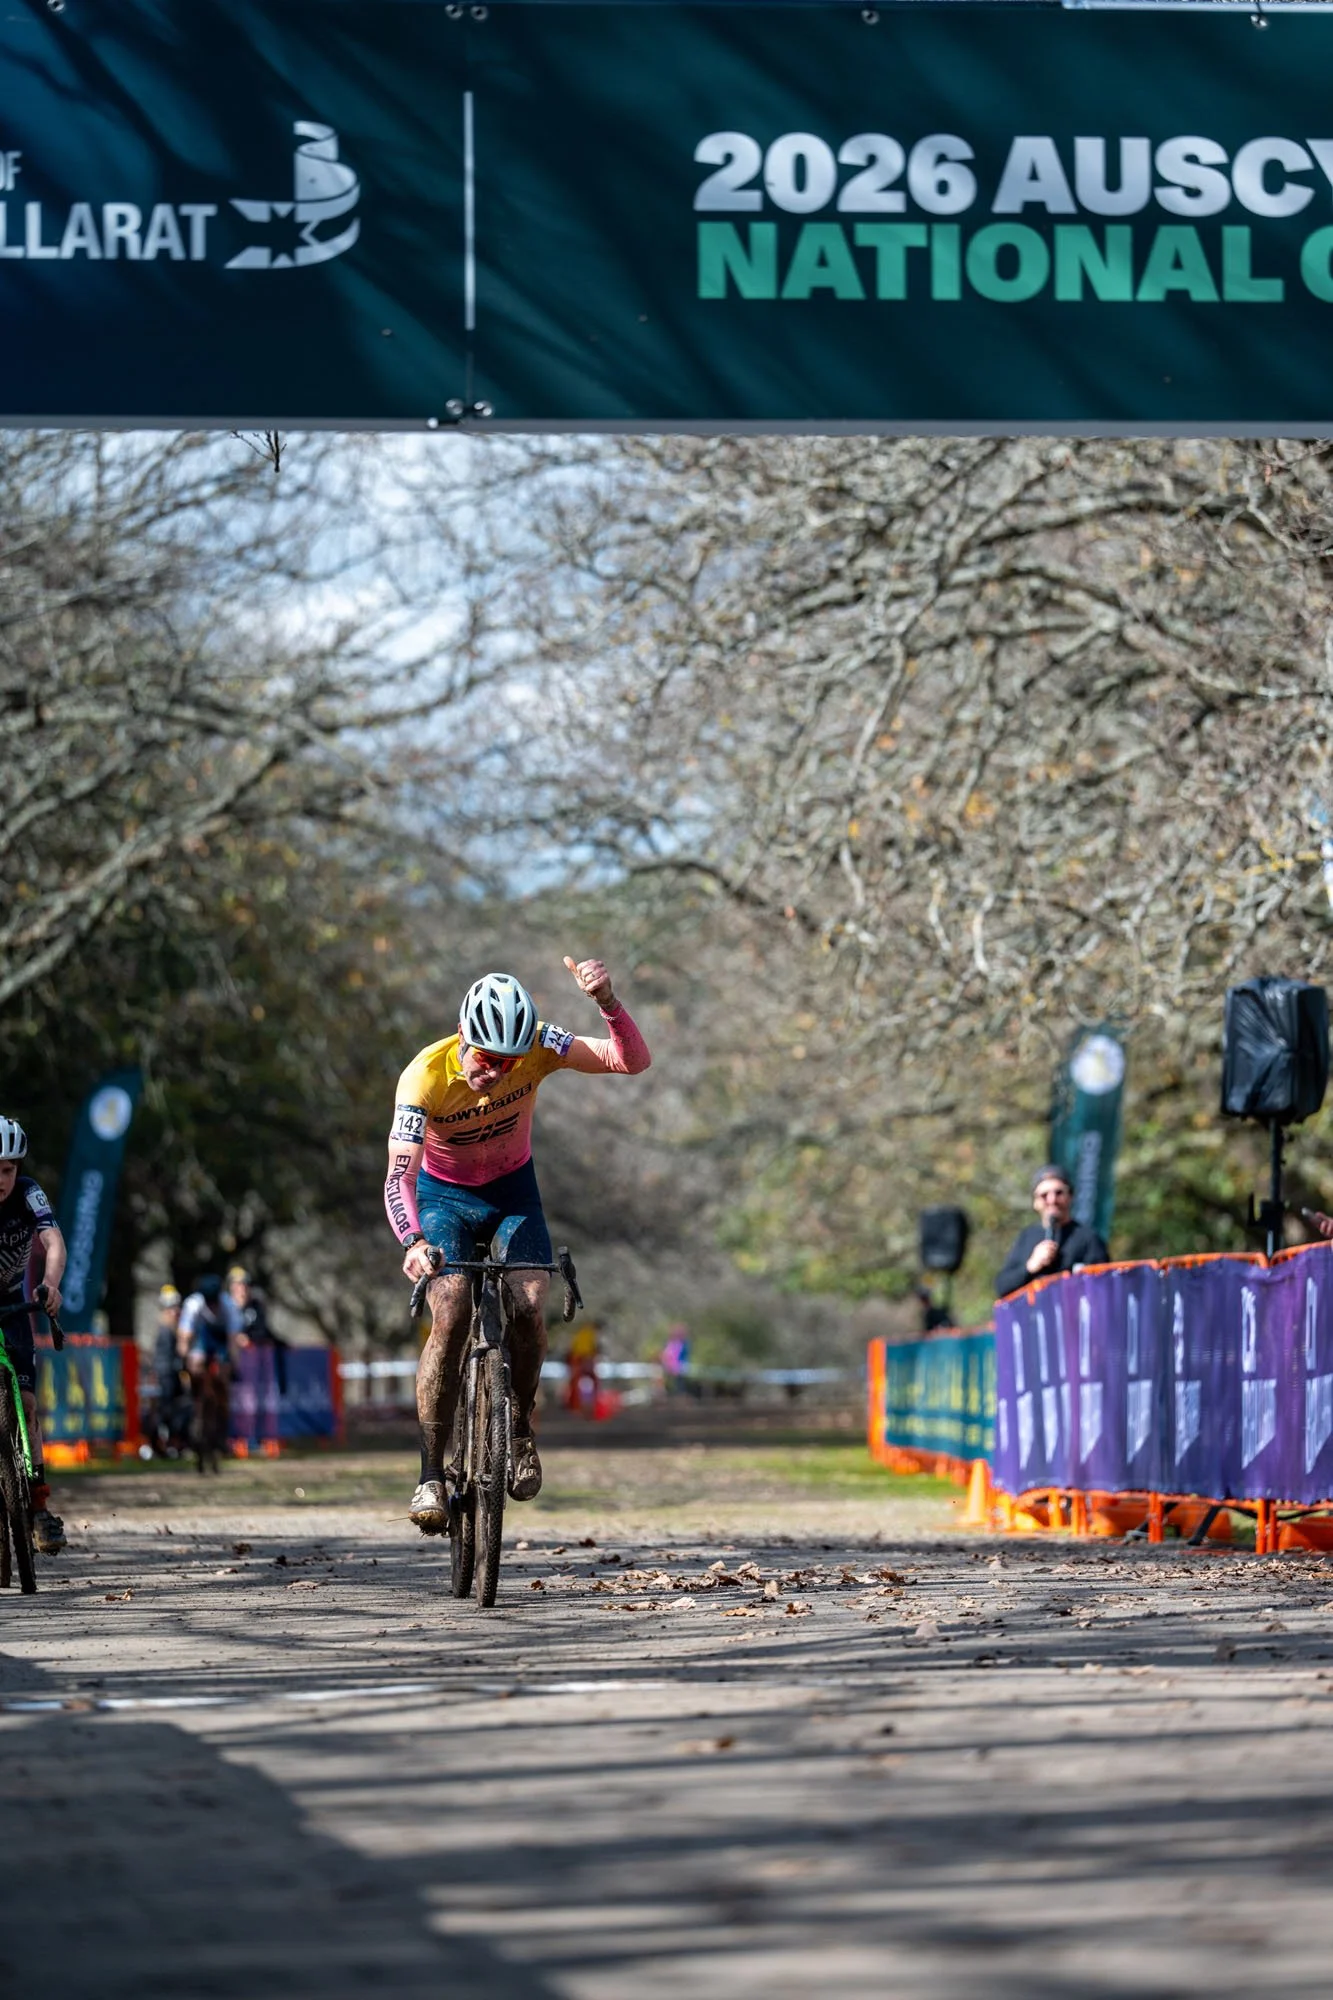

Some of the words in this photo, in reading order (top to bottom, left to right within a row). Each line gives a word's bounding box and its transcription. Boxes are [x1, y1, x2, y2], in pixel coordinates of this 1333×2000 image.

[693, 130, 978, 215] 2026
[0, 200, 217, 261] LLARAT
[697, 221, 1285, 302] NATIONAL
[398, 1114, 423, 1134] 142
[0, 1228, 28, 1247] tpix
